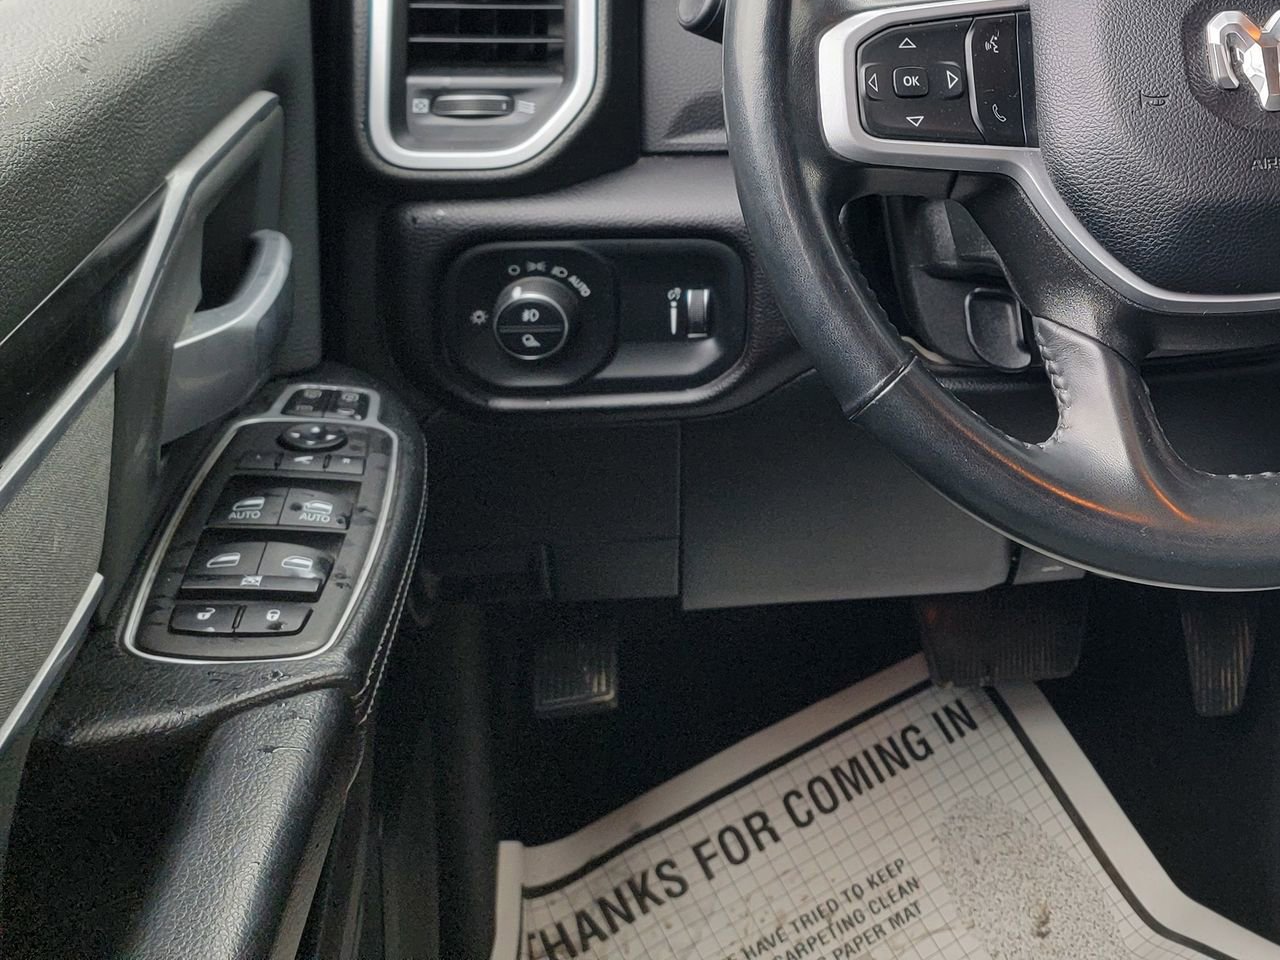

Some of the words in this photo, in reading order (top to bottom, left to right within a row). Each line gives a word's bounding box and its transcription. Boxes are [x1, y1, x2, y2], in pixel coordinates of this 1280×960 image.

[903, 76, 920, 87] OK
[567, 275, 591, 297] AUTO
[228, 510, 261, 520] AUTO
[299, 513, 330, 523] AUTO
[692, 810, 781, 881] FOR
[783, 724, 934, 828] COMING
[931, 698, 978, 744] IN
[740, 926, 789, 960] HAVE
[790, 898, 840, 933] TRIED
[840, 883, 865, 904] TO
[867, 858, 906, 890] KEEP
[870, 875, 921, 915] CLEAN
[833, 925, 887, 960] PAPER
[890, 900, 924, 931] MAT
